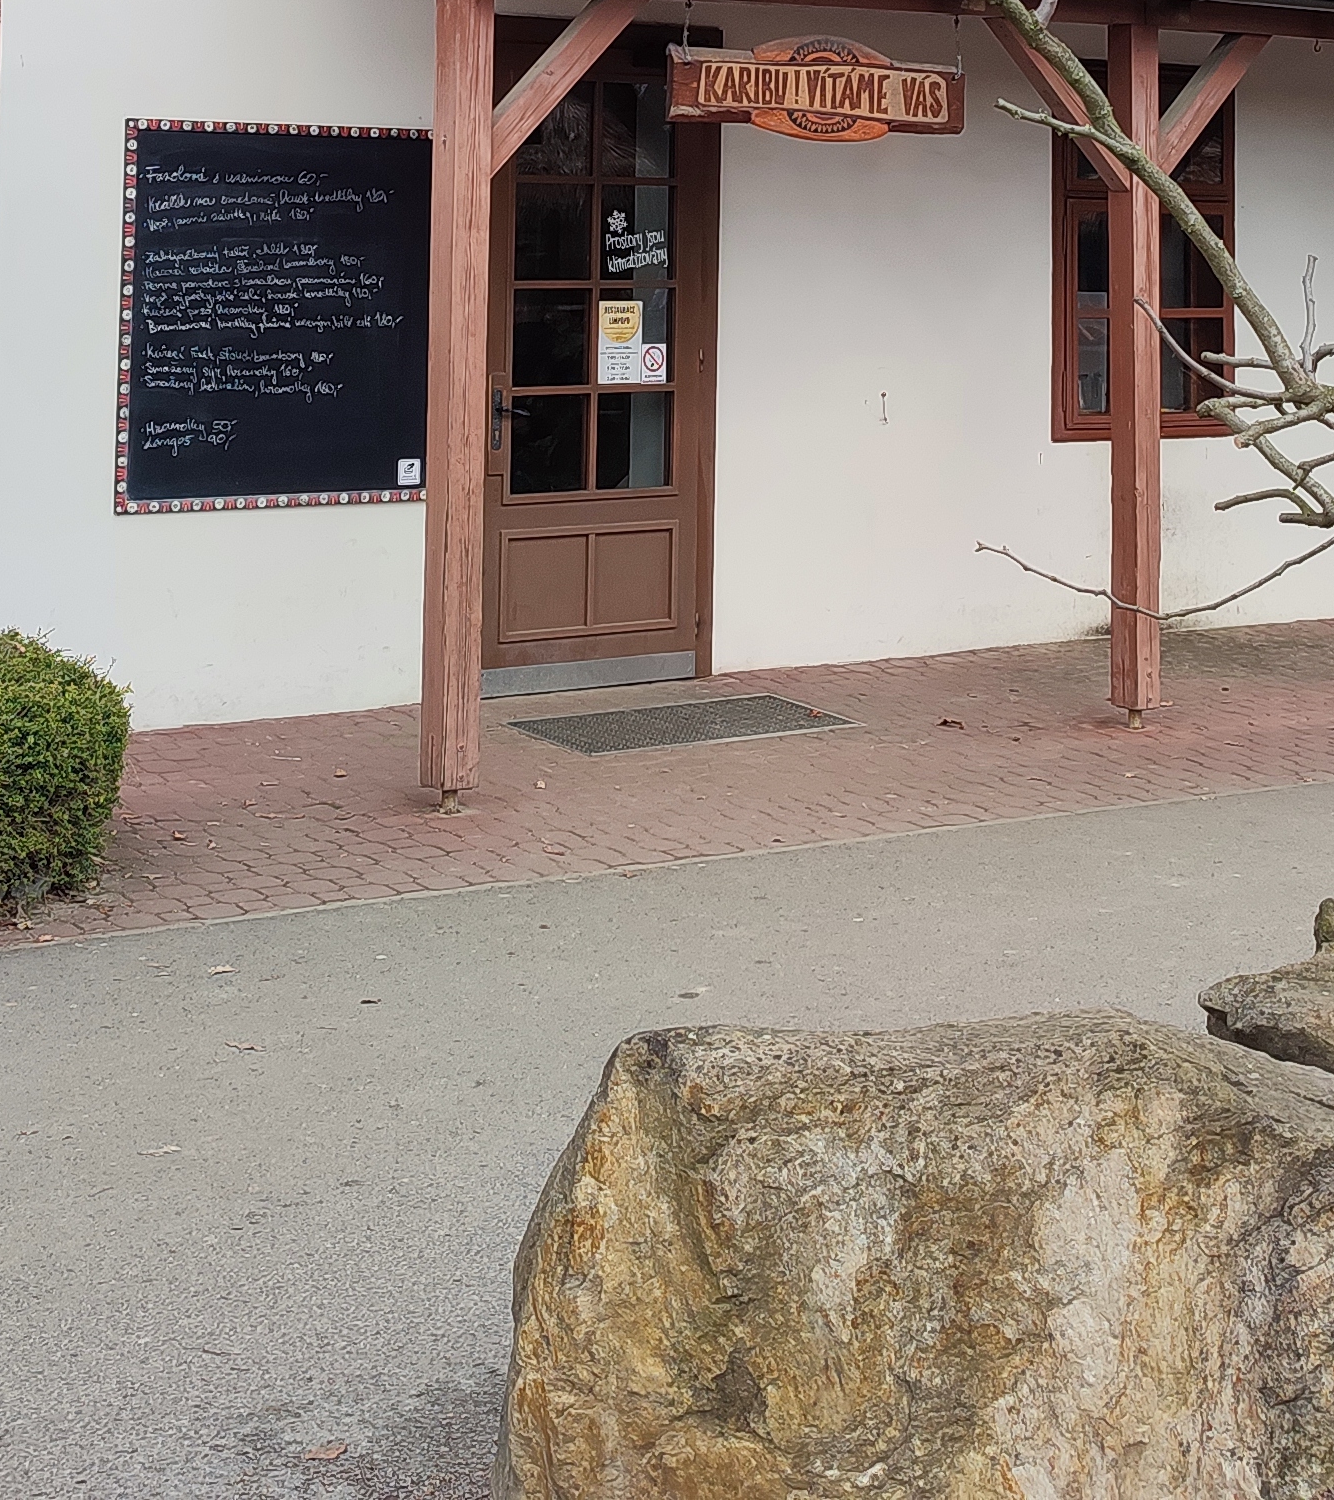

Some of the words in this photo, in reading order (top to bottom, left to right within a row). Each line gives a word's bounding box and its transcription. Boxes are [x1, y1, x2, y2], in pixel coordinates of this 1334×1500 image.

[805, 67, 891, 115] VÍTÁME
[900, 74, 945, 119] VÁS
[605, 231, 643, 252] Prostory
[645, 229, 664, 251] jsou
[607, 247, 669, 273] klimatizovány
[146, 417, 206, 441] Hranolky
